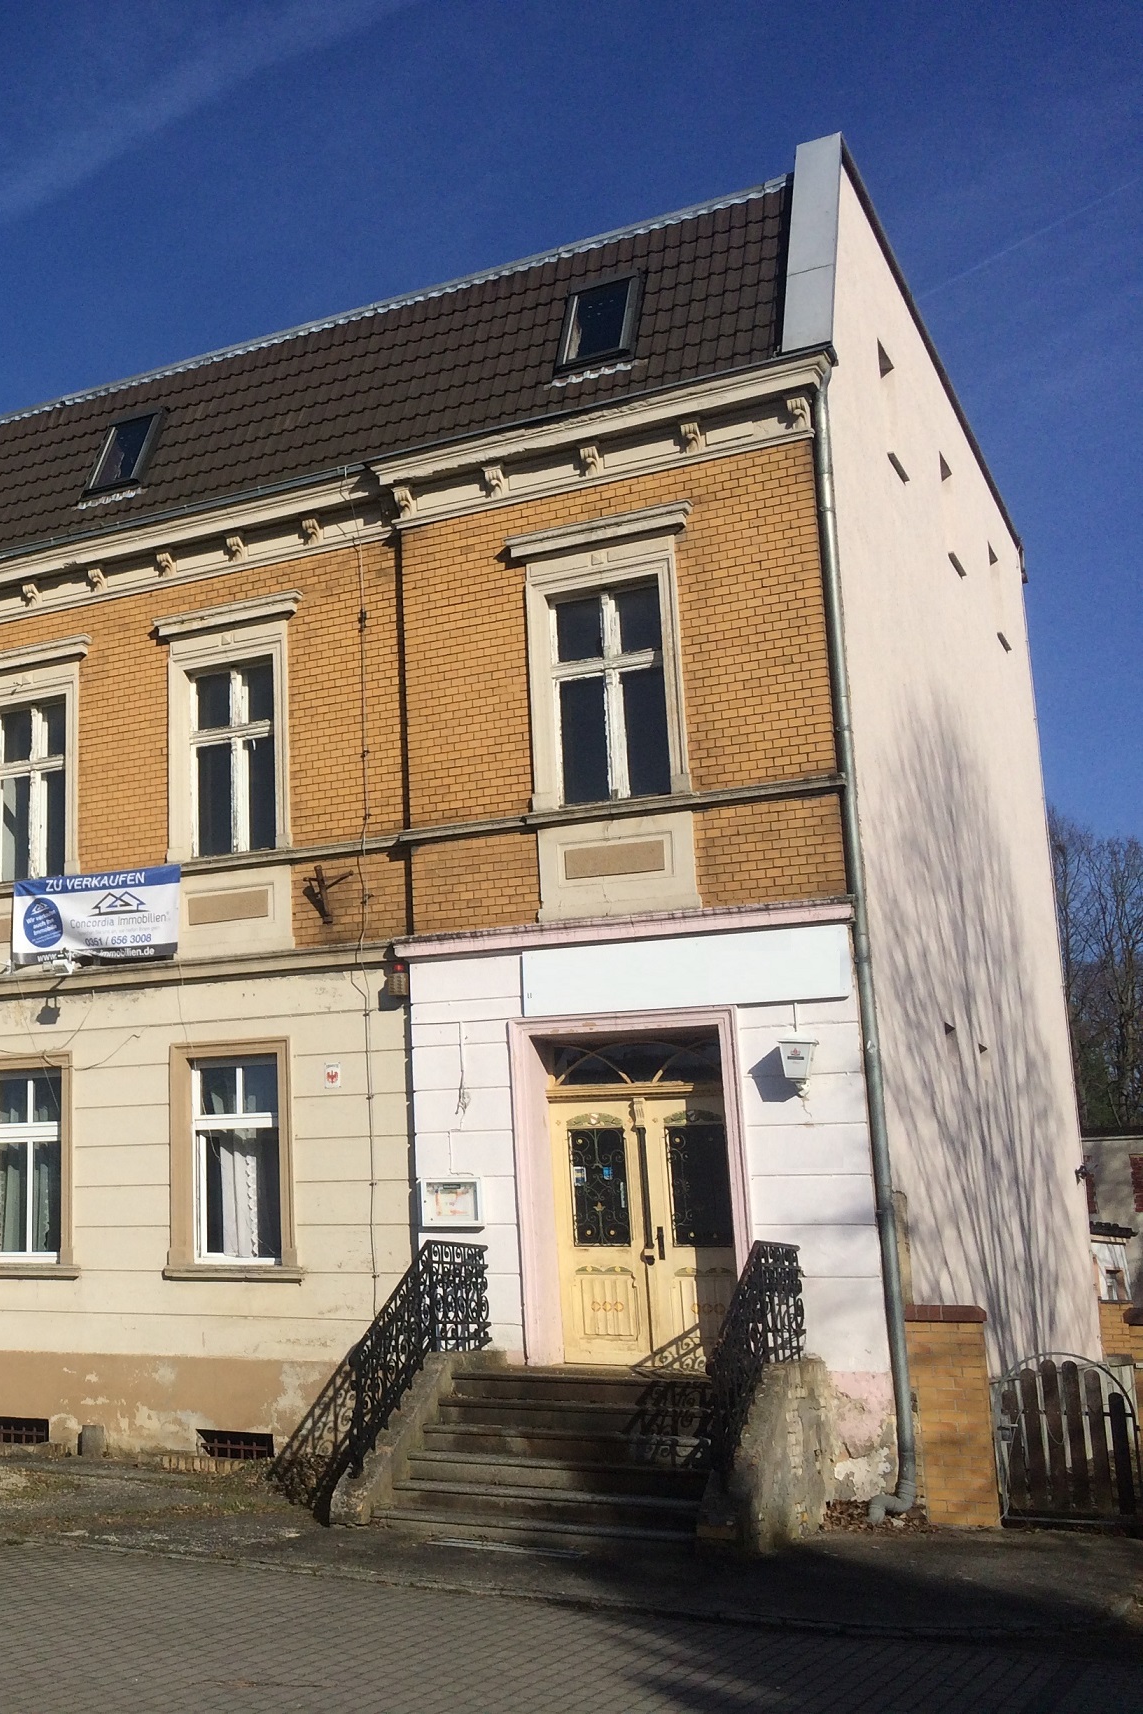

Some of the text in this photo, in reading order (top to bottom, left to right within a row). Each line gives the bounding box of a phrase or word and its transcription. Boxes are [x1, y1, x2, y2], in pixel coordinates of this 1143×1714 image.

[45, 872, 145, 892] ZU VERKAUFEN
[70, 913, 167, 929] Concordia Immobilien
[85, 933, 152, 946] 0351 / 656 3008
